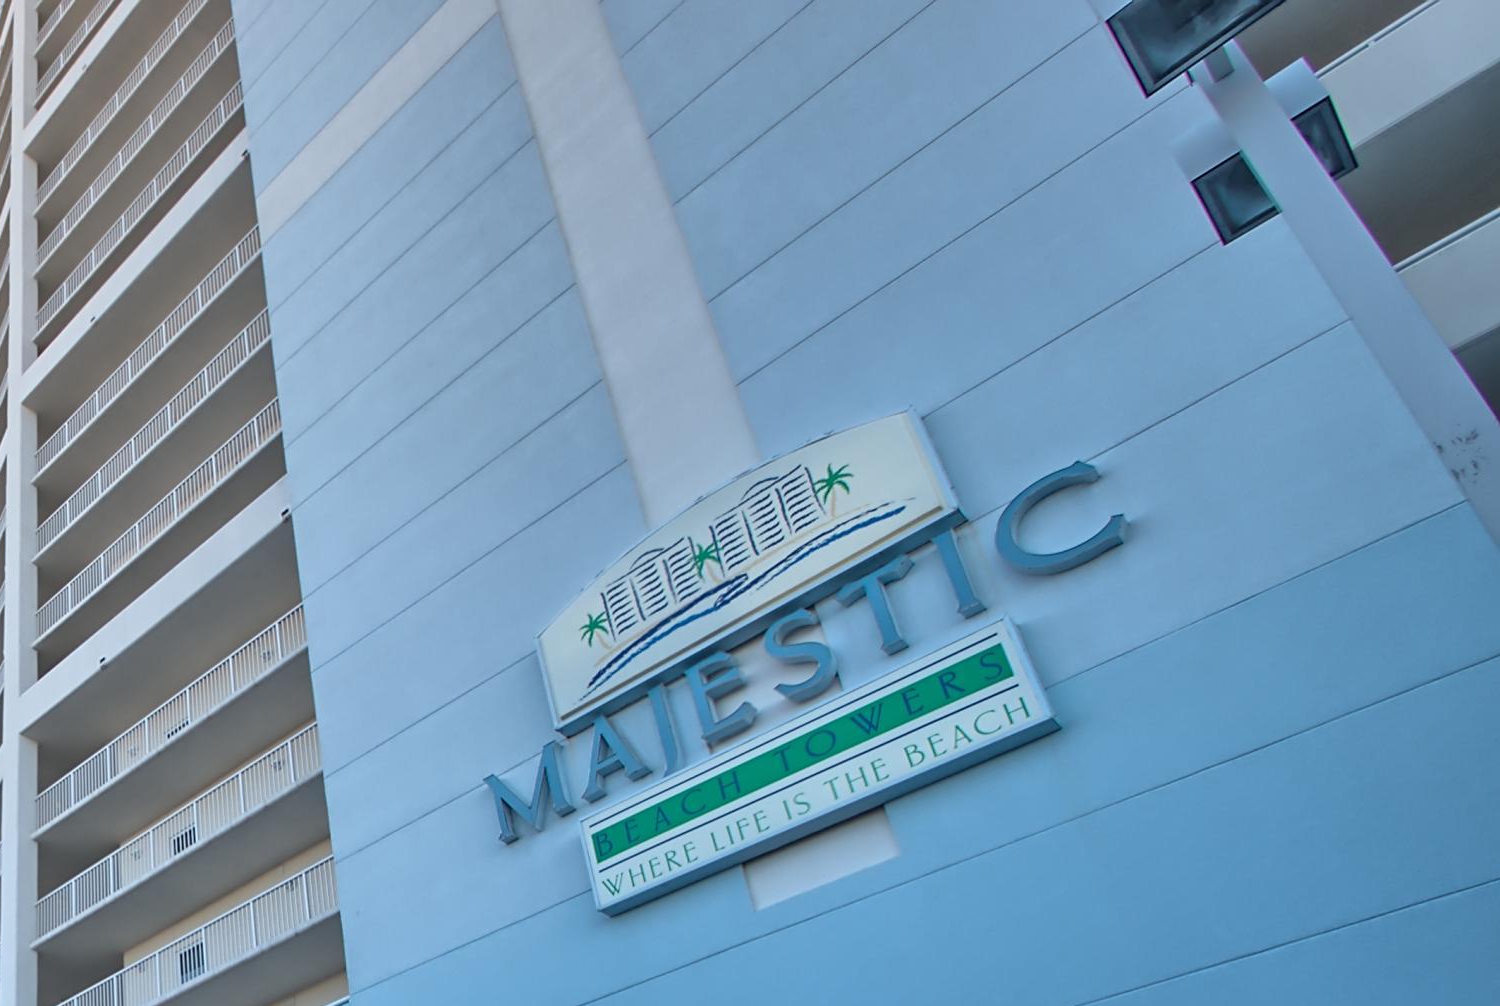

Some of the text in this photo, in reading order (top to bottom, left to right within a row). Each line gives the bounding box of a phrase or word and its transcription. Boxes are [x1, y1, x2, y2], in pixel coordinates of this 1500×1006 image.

[483, 460, 1132, 845] MAJESTIC
[594, 651, 1005, 857] BEACH TOWERS
[602, 696, 1032, 896] WHERE LIFE IS THE BEACH
